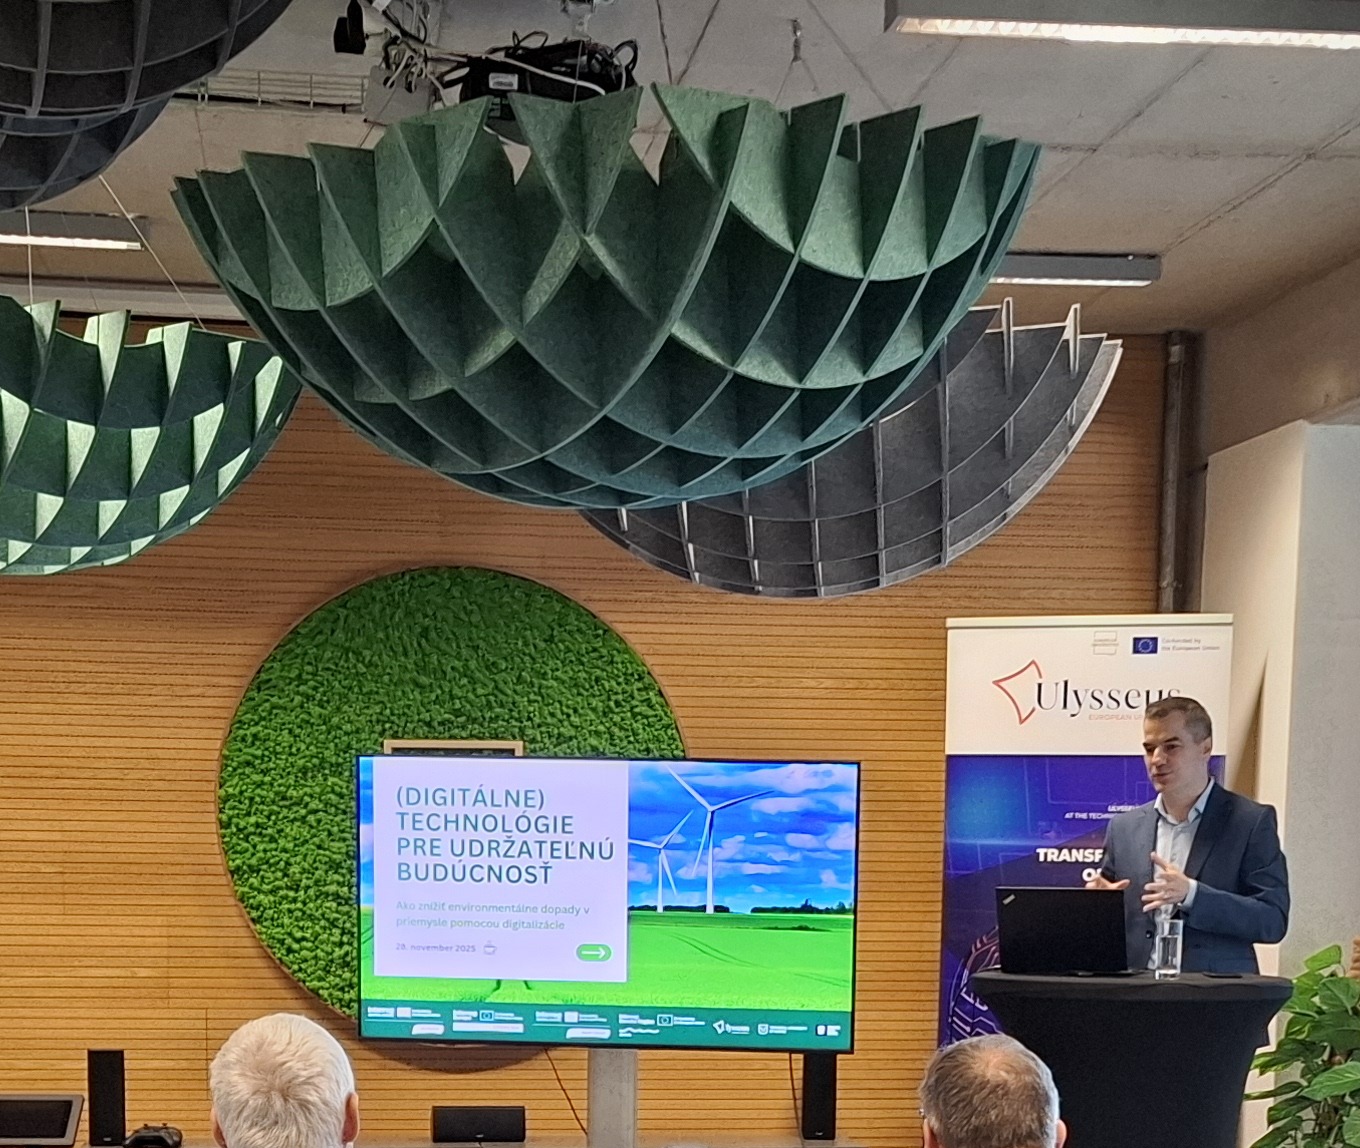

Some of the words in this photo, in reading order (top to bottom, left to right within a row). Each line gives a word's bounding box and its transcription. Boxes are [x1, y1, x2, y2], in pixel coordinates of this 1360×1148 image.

[396, 784, 545, 810] (DIGITÁLNE)
[396, 810, 574, 834] TECHNOLÓGIE
[397, 837, 442, 857] PRE
[450, 836, 614, 860] UDRŽATEĽNÚ
[1036, 848, 1104, 862] TRANSF
[397, 859, 553, 884] BUDÚCNOSŤ
[396, 901, 416, 911] Ako
[540, 904, 581, 916] dopady
[583, 906, 590, 914] v
[450, 918, 500, 929] pomocou
